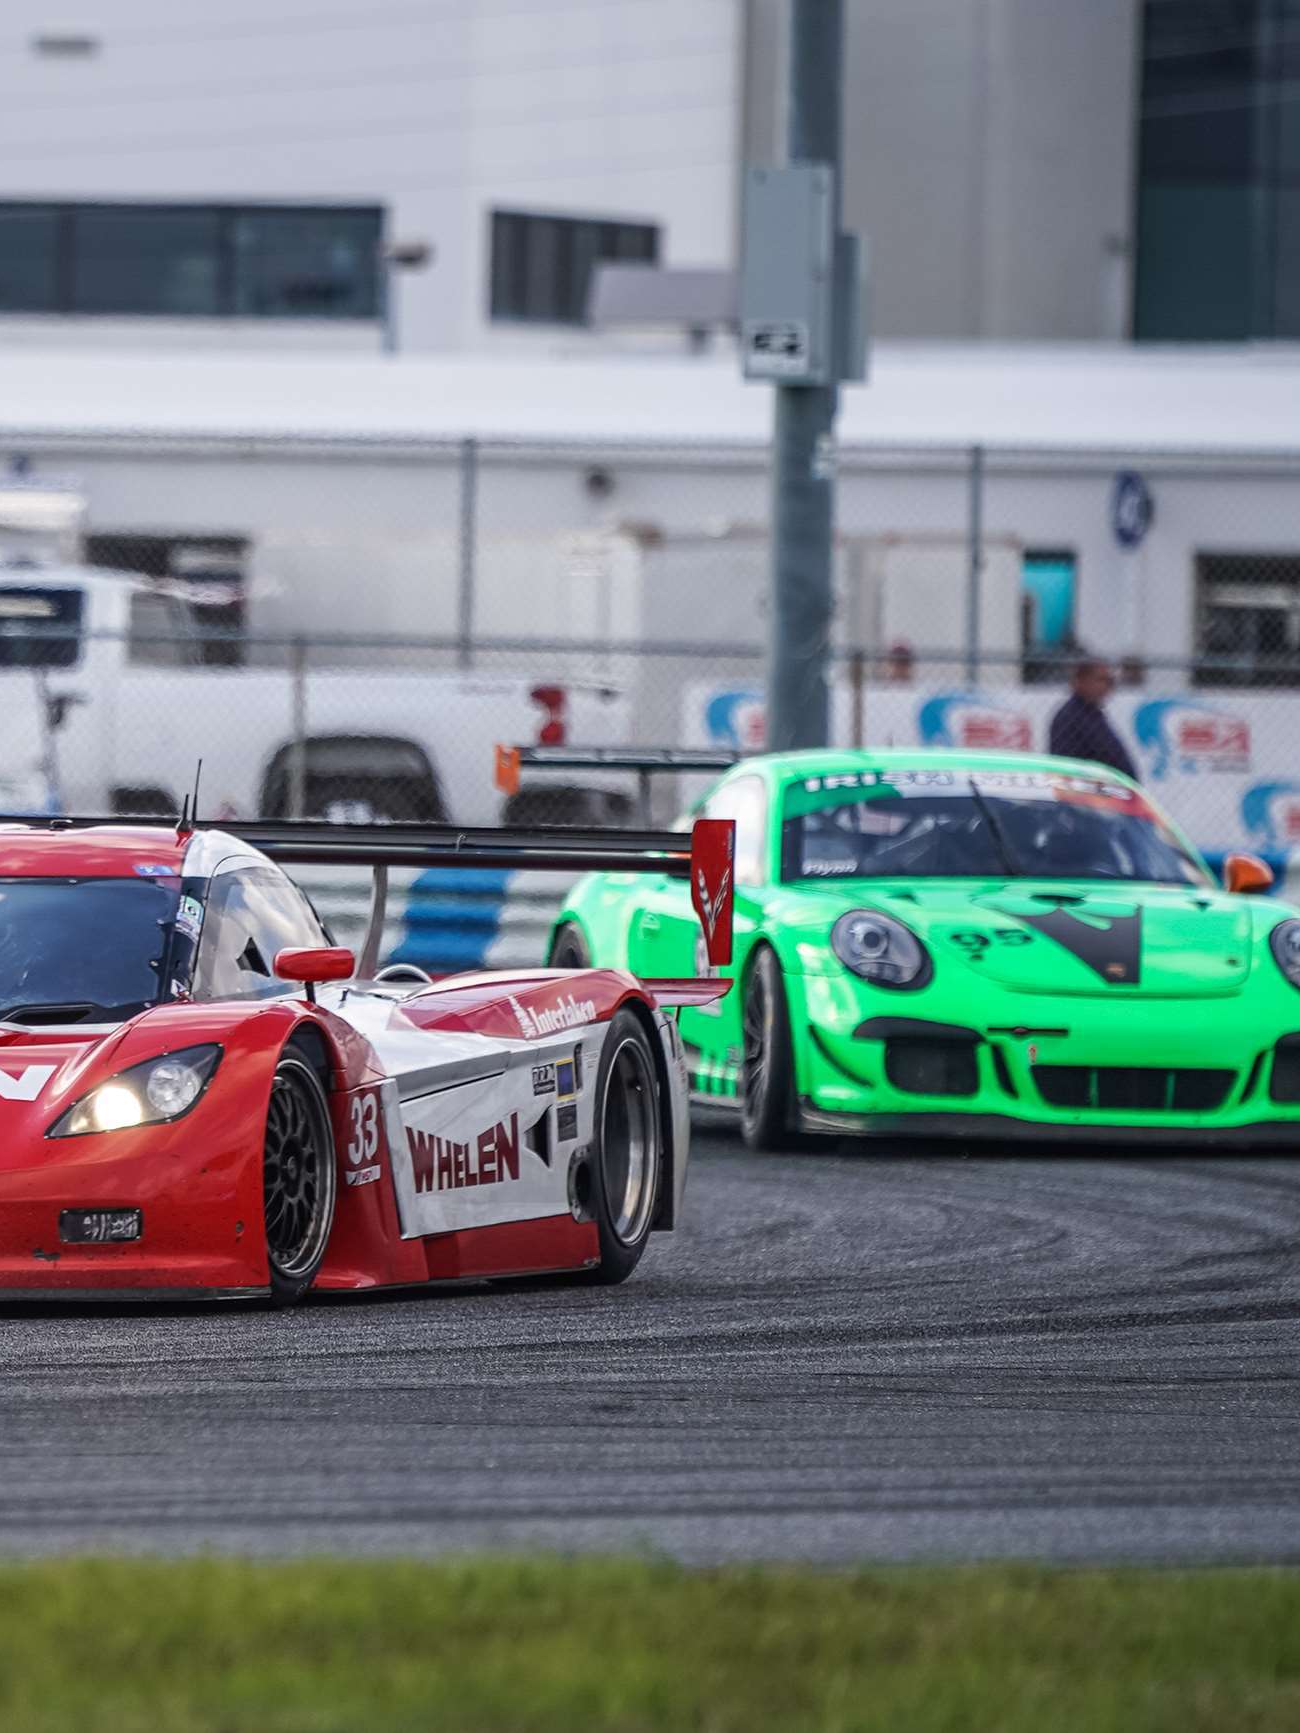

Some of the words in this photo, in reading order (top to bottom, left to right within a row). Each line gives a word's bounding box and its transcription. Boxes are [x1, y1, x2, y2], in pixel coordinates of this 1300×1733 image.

[950, 928, 1032, 961] 95
[348, 1093, 378, 1165] 33
[405, 1111, 520, 1194] WHELEN
